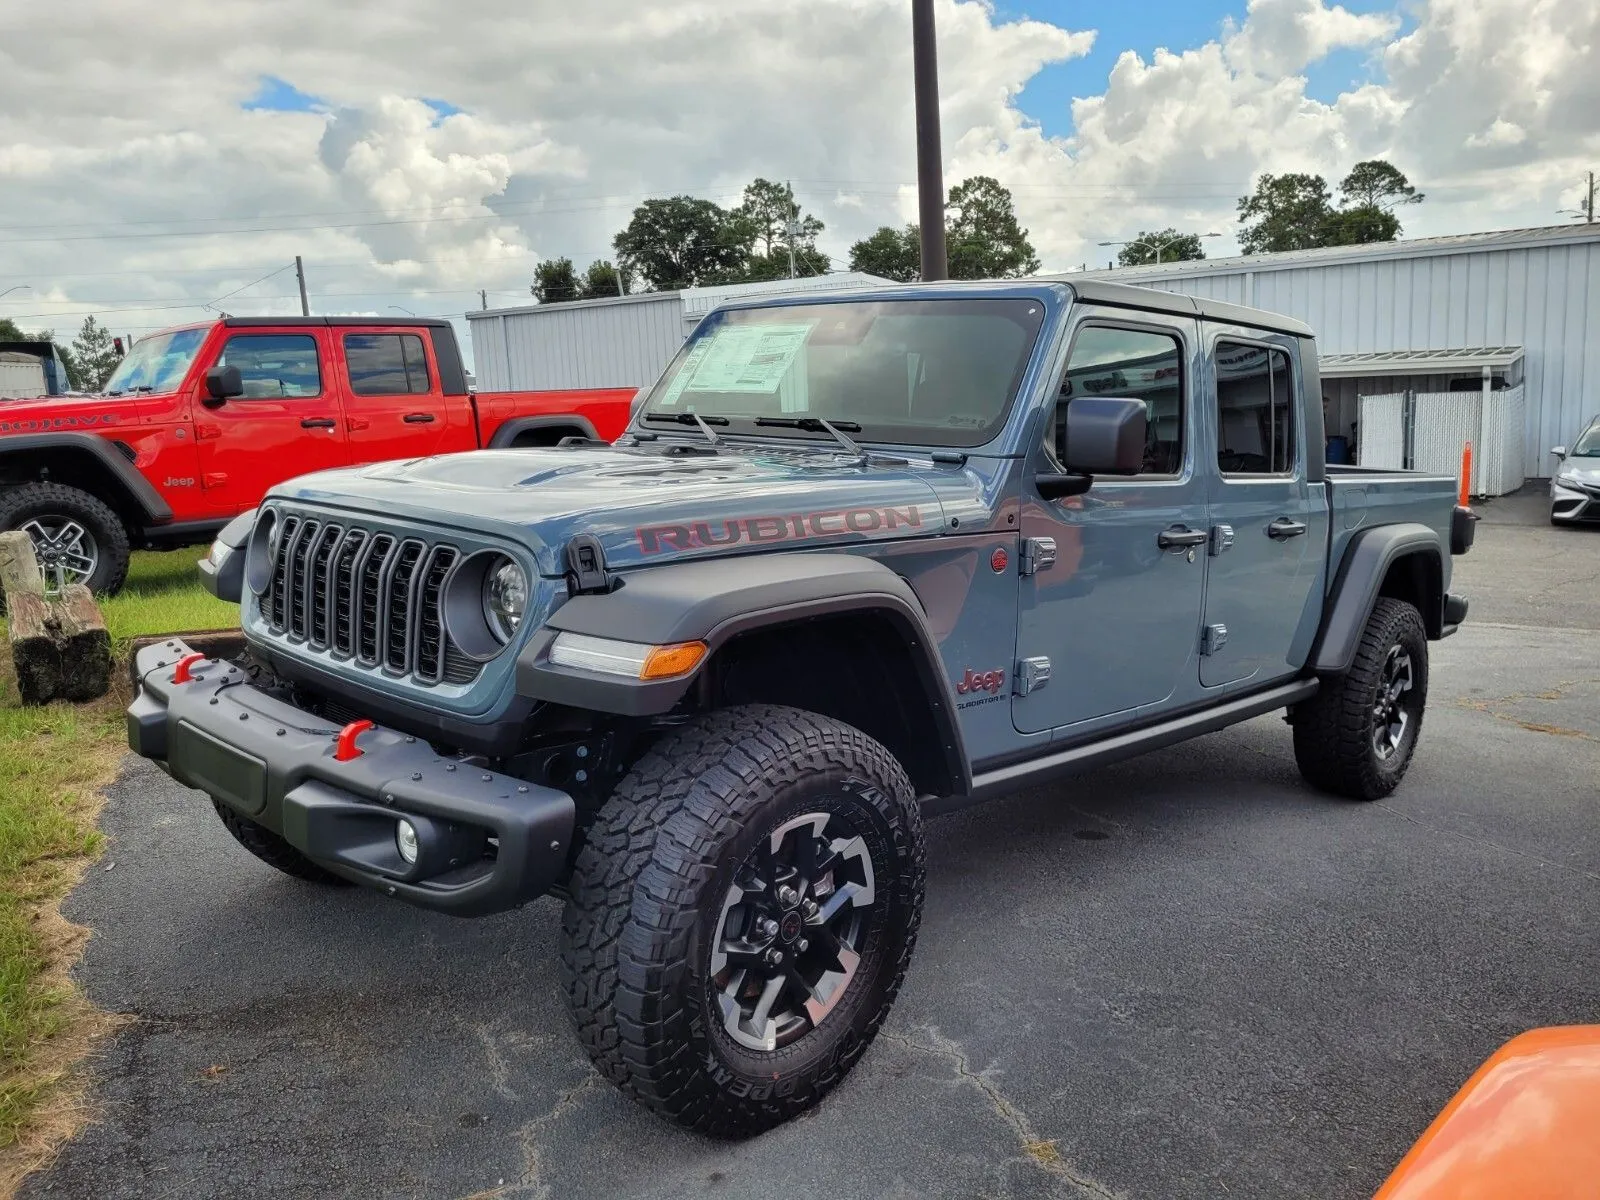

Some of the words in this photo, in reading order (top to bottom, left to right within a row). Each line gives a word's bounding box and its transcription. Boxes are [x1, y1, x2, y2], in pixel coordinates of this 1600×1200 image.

[163, 477, 195, 488] Jeep
[636, 506, 922, 554] RUBICON
[956, 668, 1006, 695] Jeep
[956, 696, 999, 710] GLADIATOR
